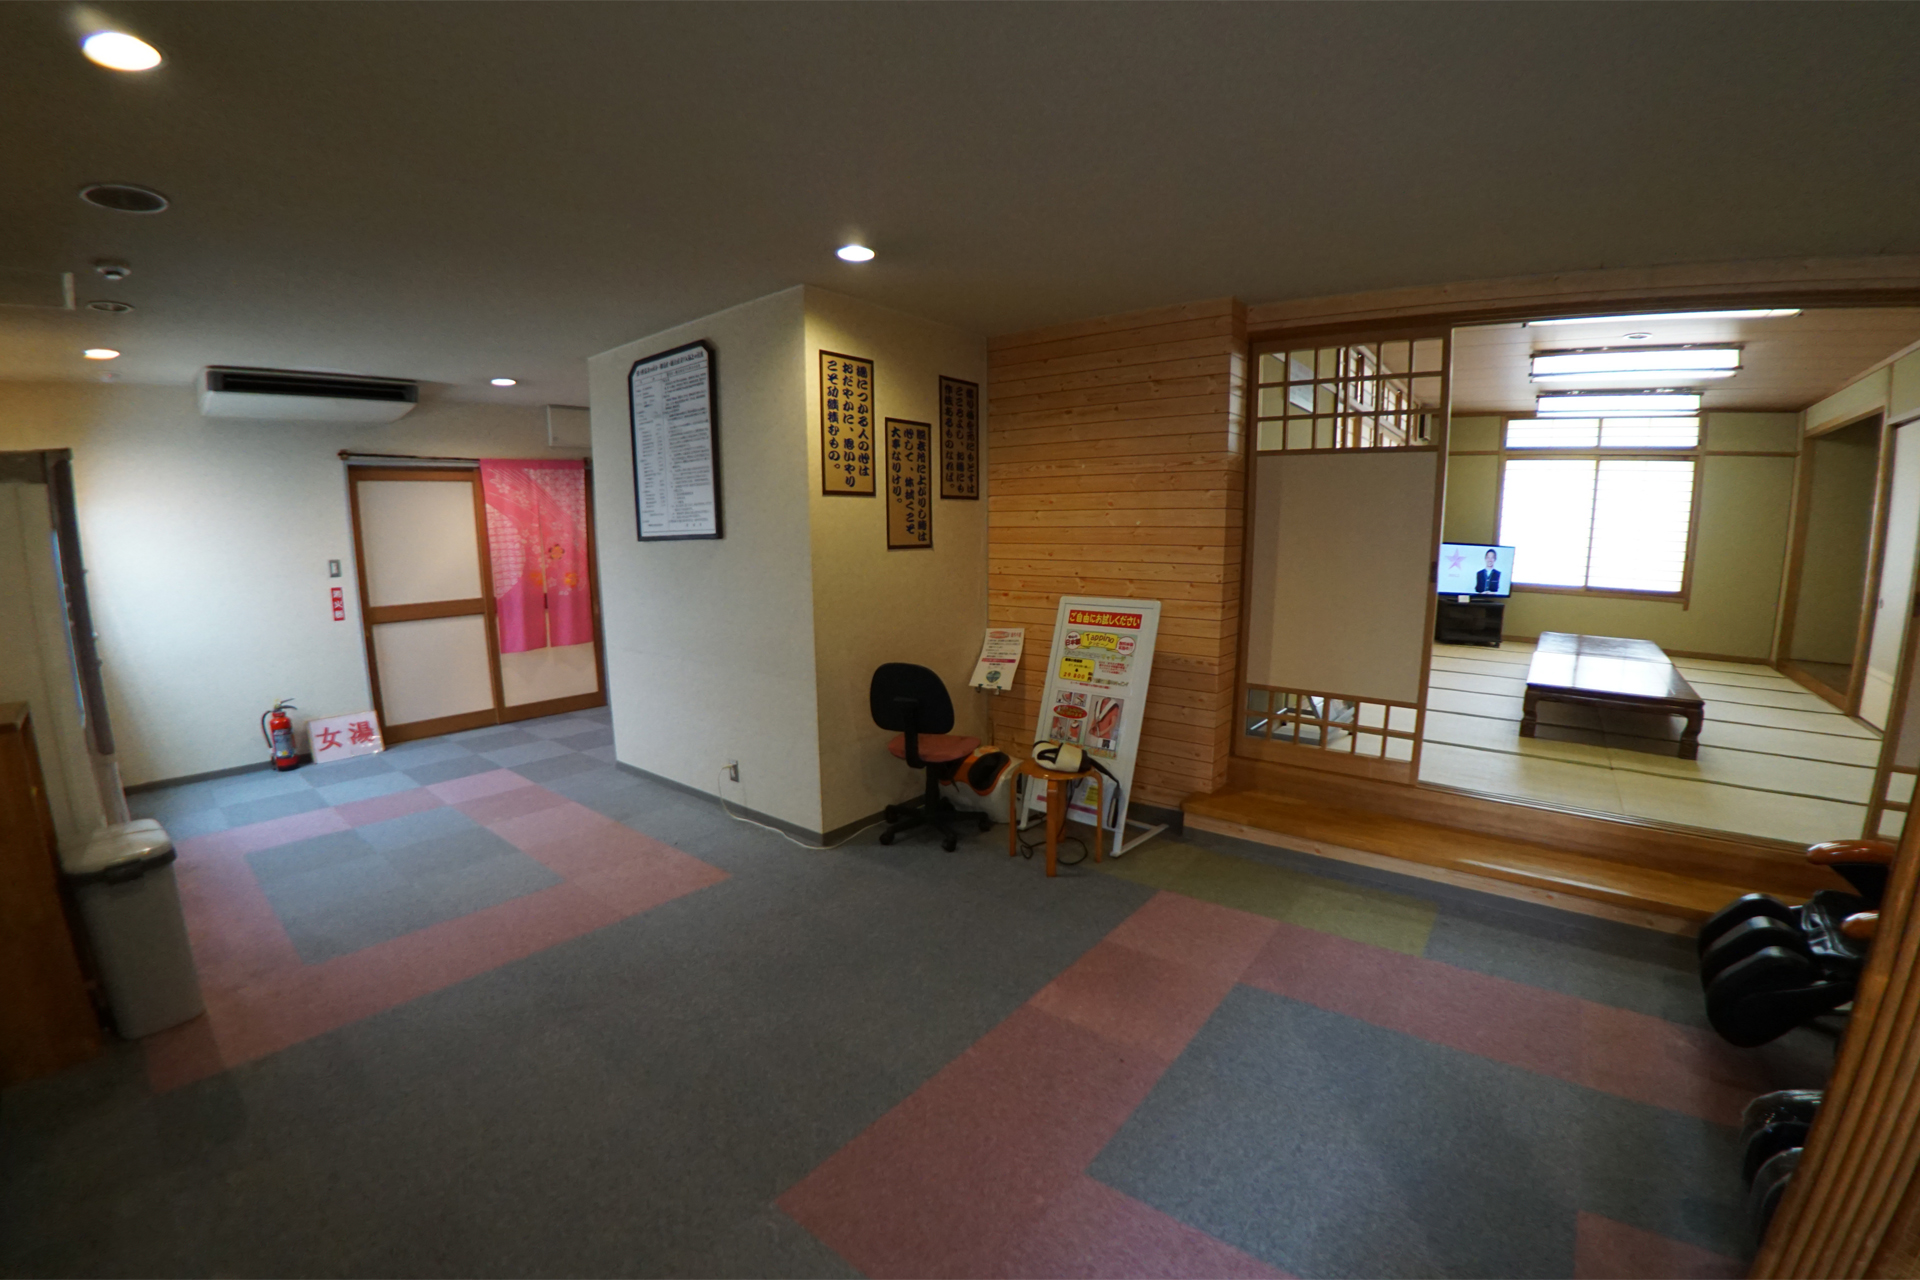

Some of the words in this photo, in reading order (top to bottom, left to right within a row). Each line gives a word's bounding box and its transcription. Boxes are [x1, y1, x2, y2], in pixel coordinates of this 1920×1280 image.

[1070, 612, 1140, 626] ご自由にお試しください
[1085, 633, 1115, 644] Tappino
[314, 721, 374, 752] 女湯
